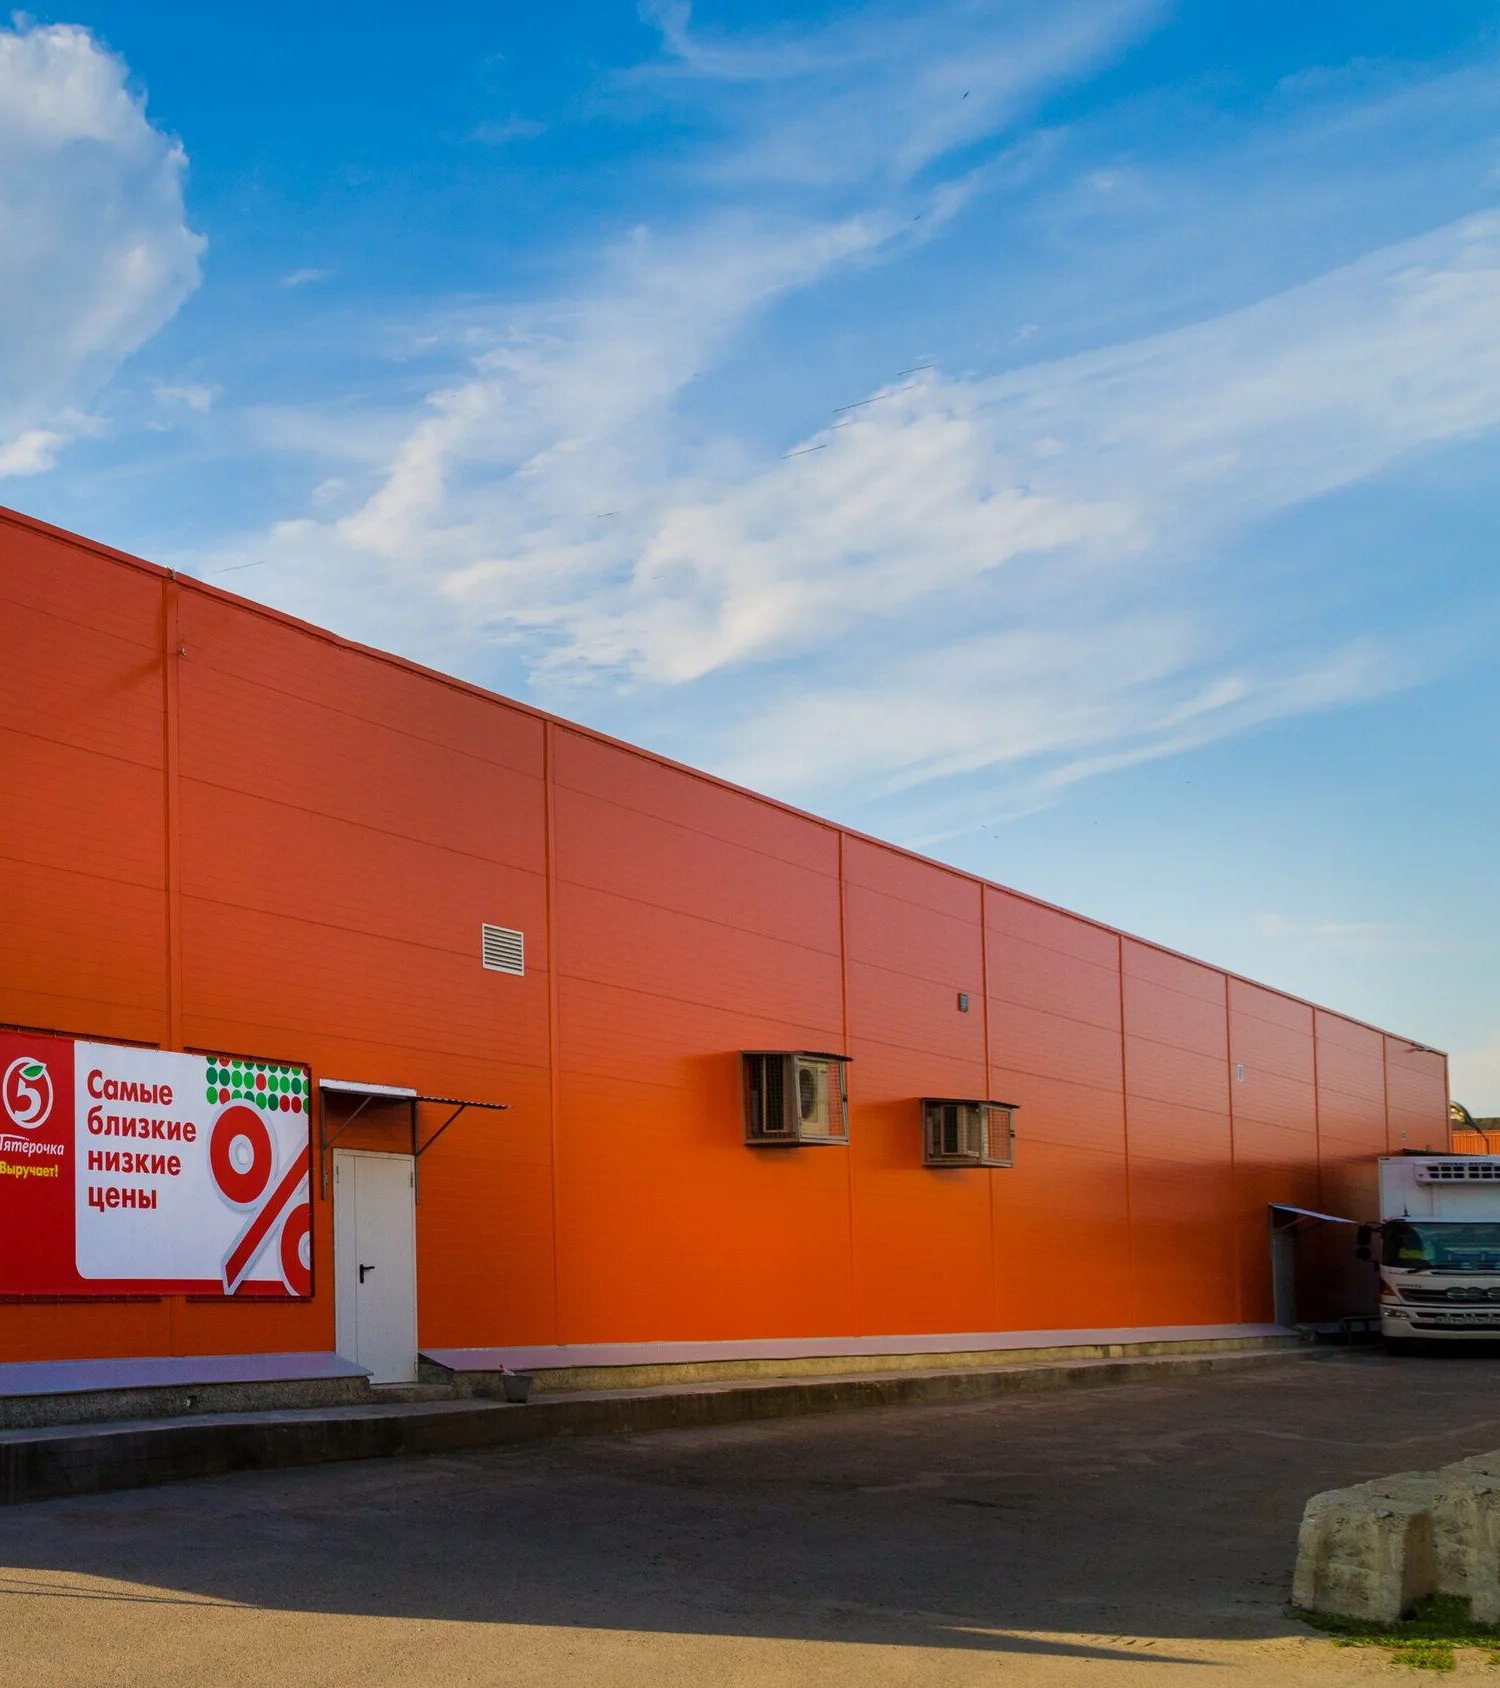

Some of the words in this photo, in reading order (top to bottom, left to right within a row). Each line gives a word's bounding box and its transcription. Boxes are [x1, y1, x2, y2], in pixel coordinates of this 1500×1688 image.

[86, 1068, 174, 1106] Самые
[87, 1105, 198, 1143] близкие
[87, 1149, 182, 1176] низкие
[87, 1186, 158, 1213] цены
